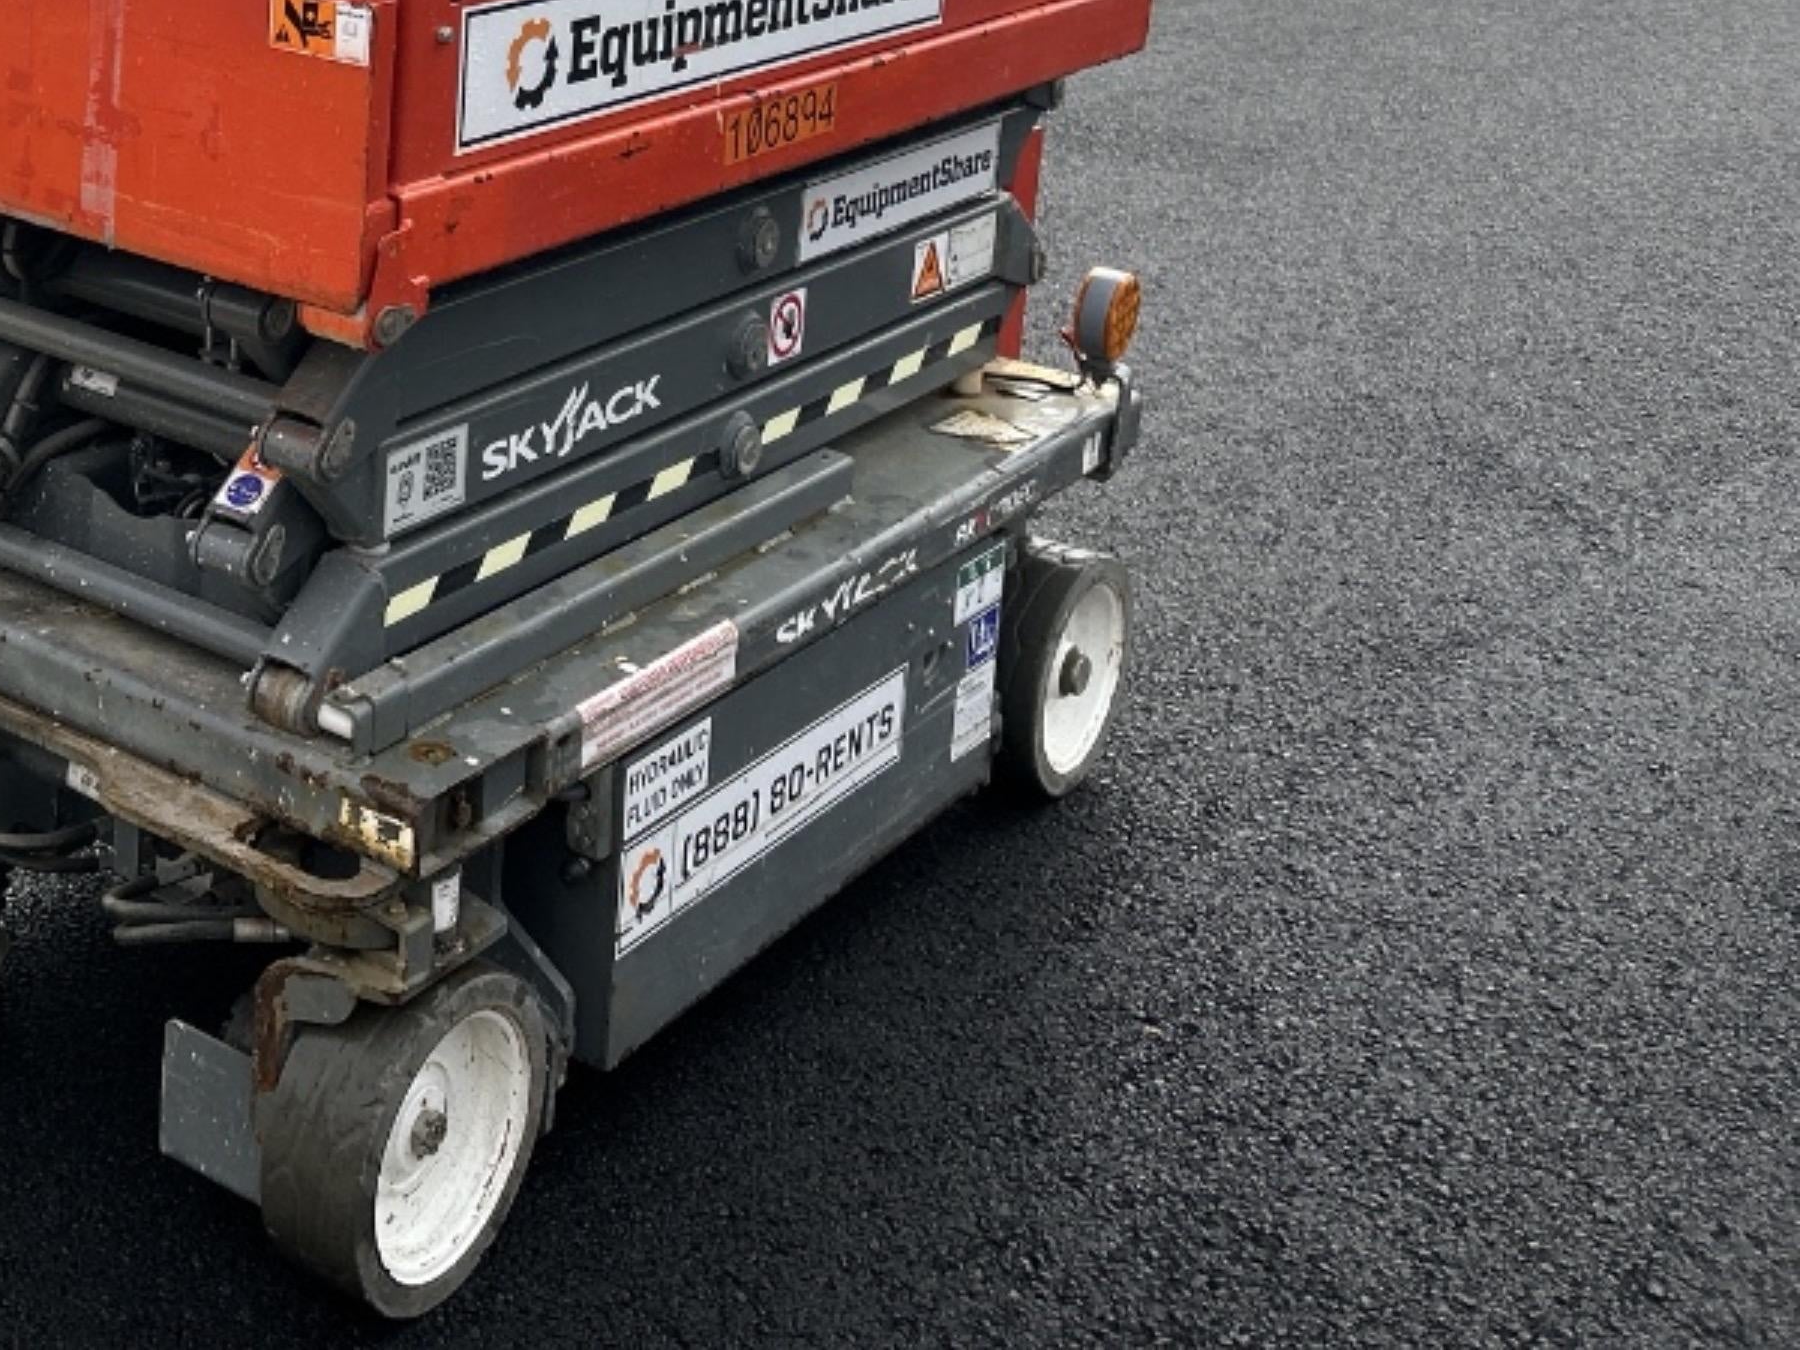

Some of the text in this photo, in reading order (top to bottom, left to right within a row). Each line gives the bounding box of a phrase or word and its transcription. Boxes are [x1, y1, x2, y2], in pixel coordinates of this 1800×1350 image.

[729, 88, 835, 160] 106894
[831, 149, 992, 229] EquipmentShare
[481, 373, 661, 481] SKYJACK
[682, 787, 761, 882] (888)
[769, 703, 894, 814] 80-RENTS
